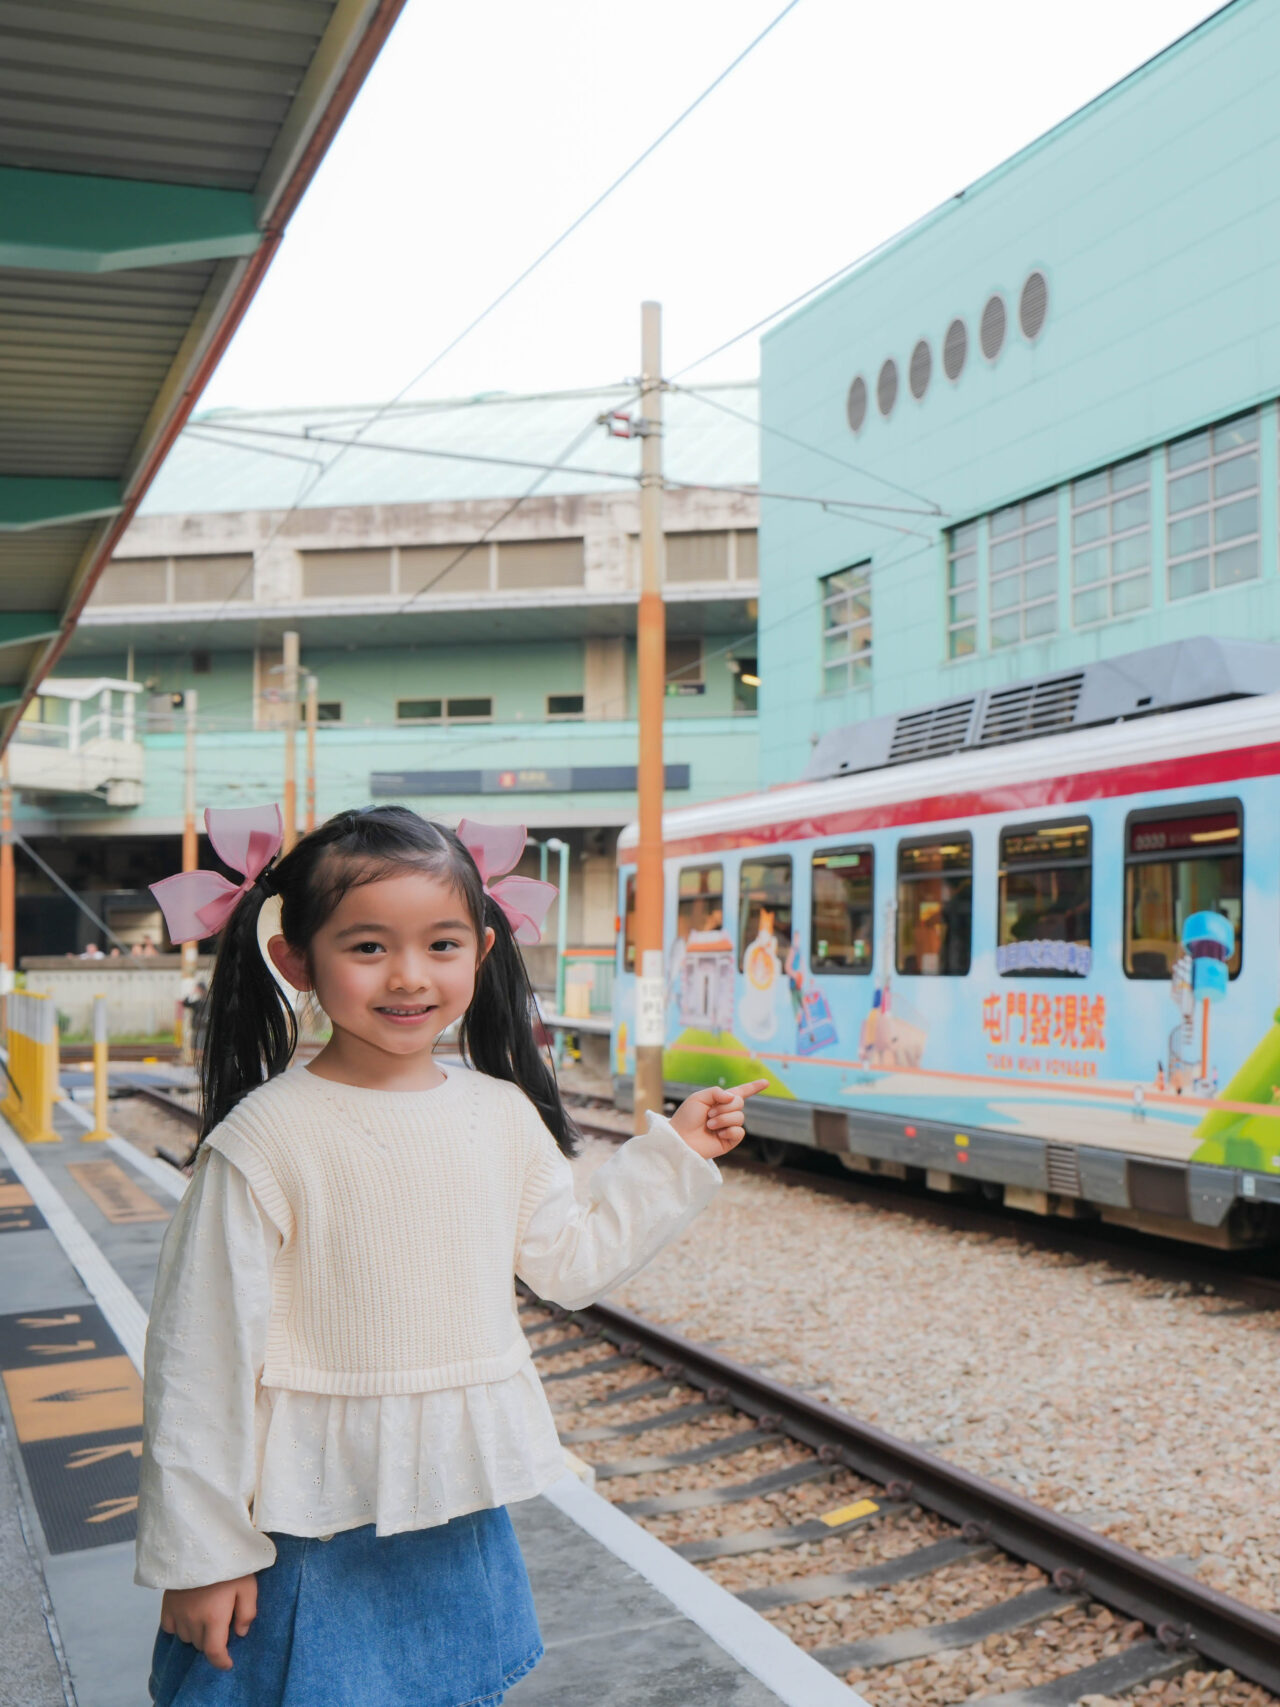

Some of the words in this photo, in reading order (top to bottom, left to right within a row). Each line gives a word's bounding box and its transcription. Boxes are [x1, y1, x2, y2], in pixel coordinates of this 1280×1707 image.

[982, 991, 1106, 1052] 屯門發現號
